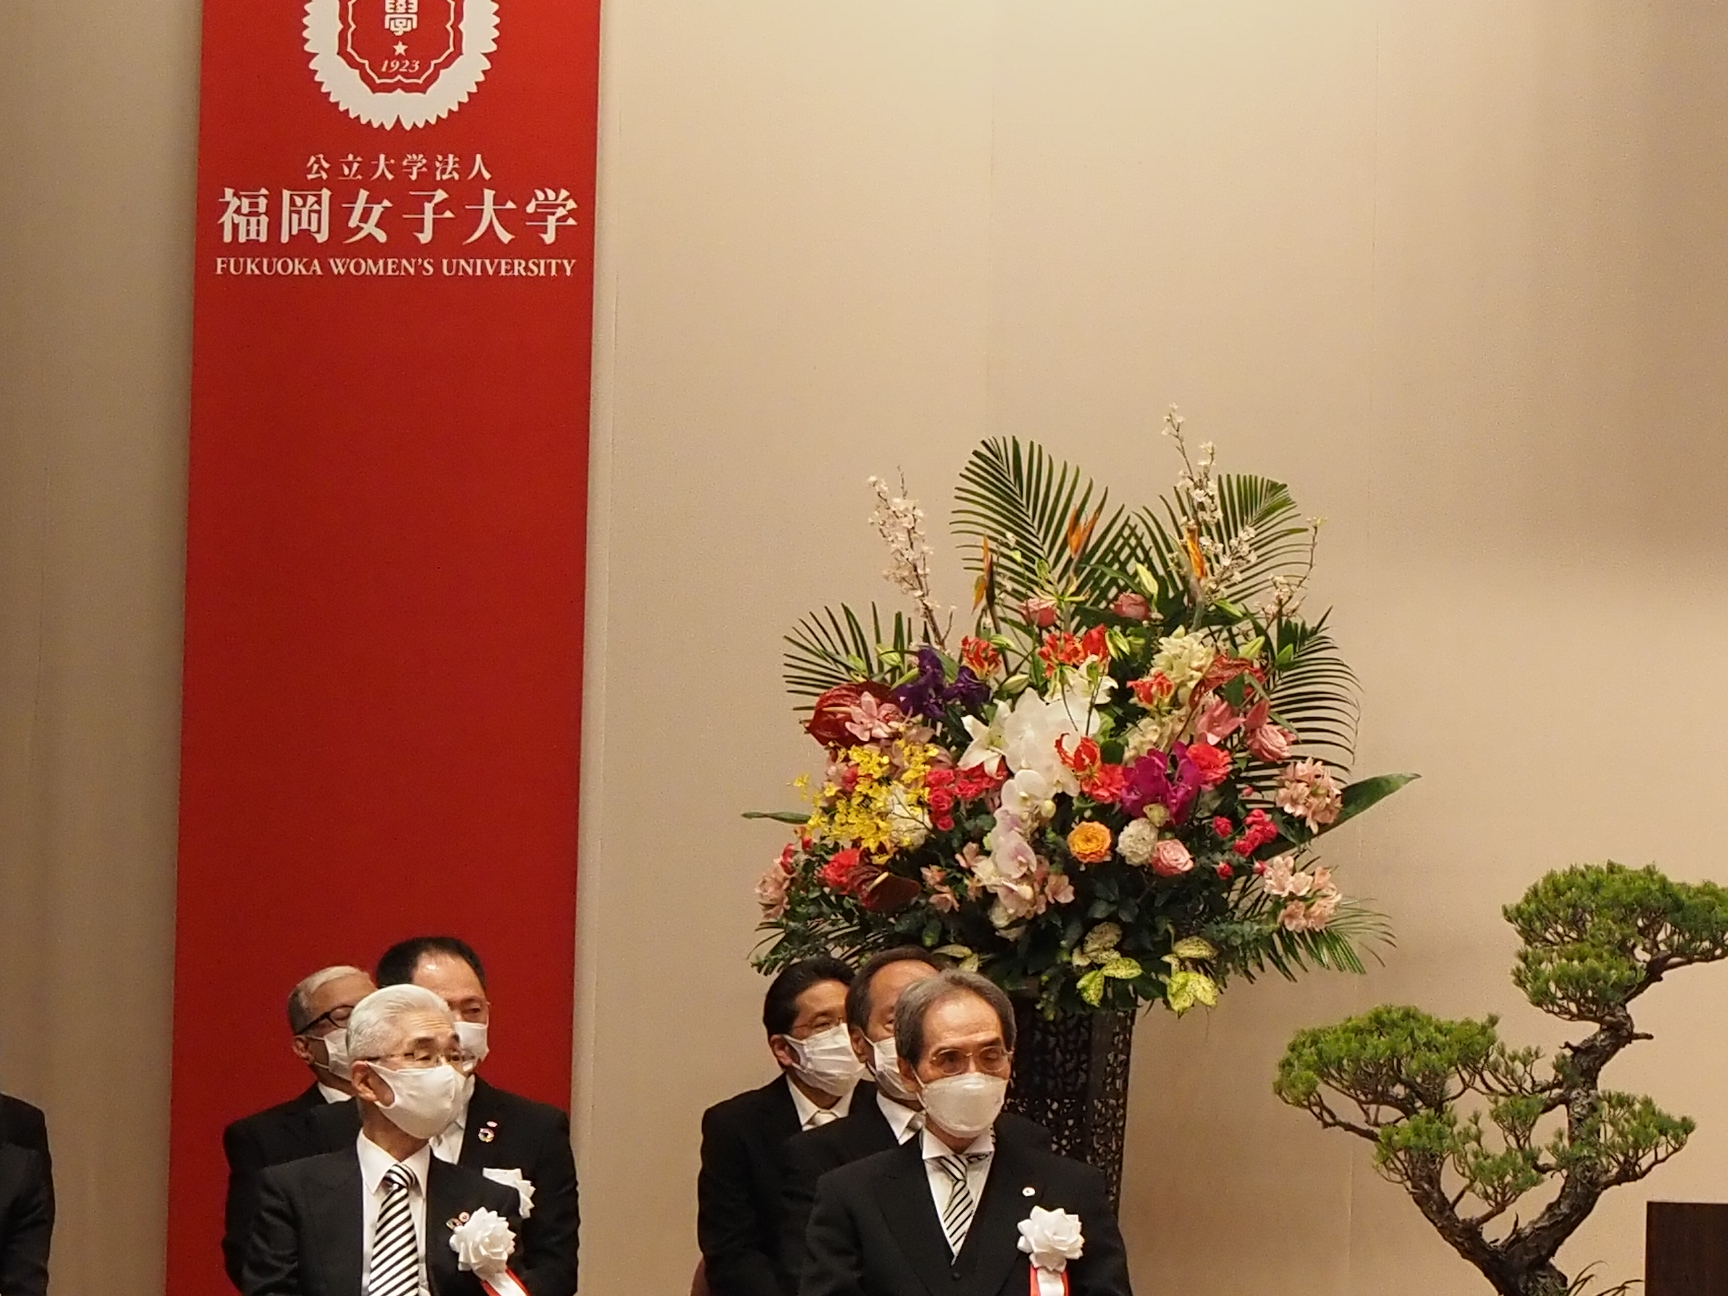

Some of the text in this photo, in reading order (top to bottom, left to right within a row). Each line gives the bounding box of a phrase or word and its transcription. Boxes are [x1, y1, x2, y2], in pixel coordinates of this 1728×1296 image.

[380, 58, 420, 73] 1923
[306, 153, 493, 182] 公立大学法人
[217, 188, 579, 246] 福岡女子大学
[215, 257, 577, 278] FUKUOKA WOMEN'S UNIVERSITY
